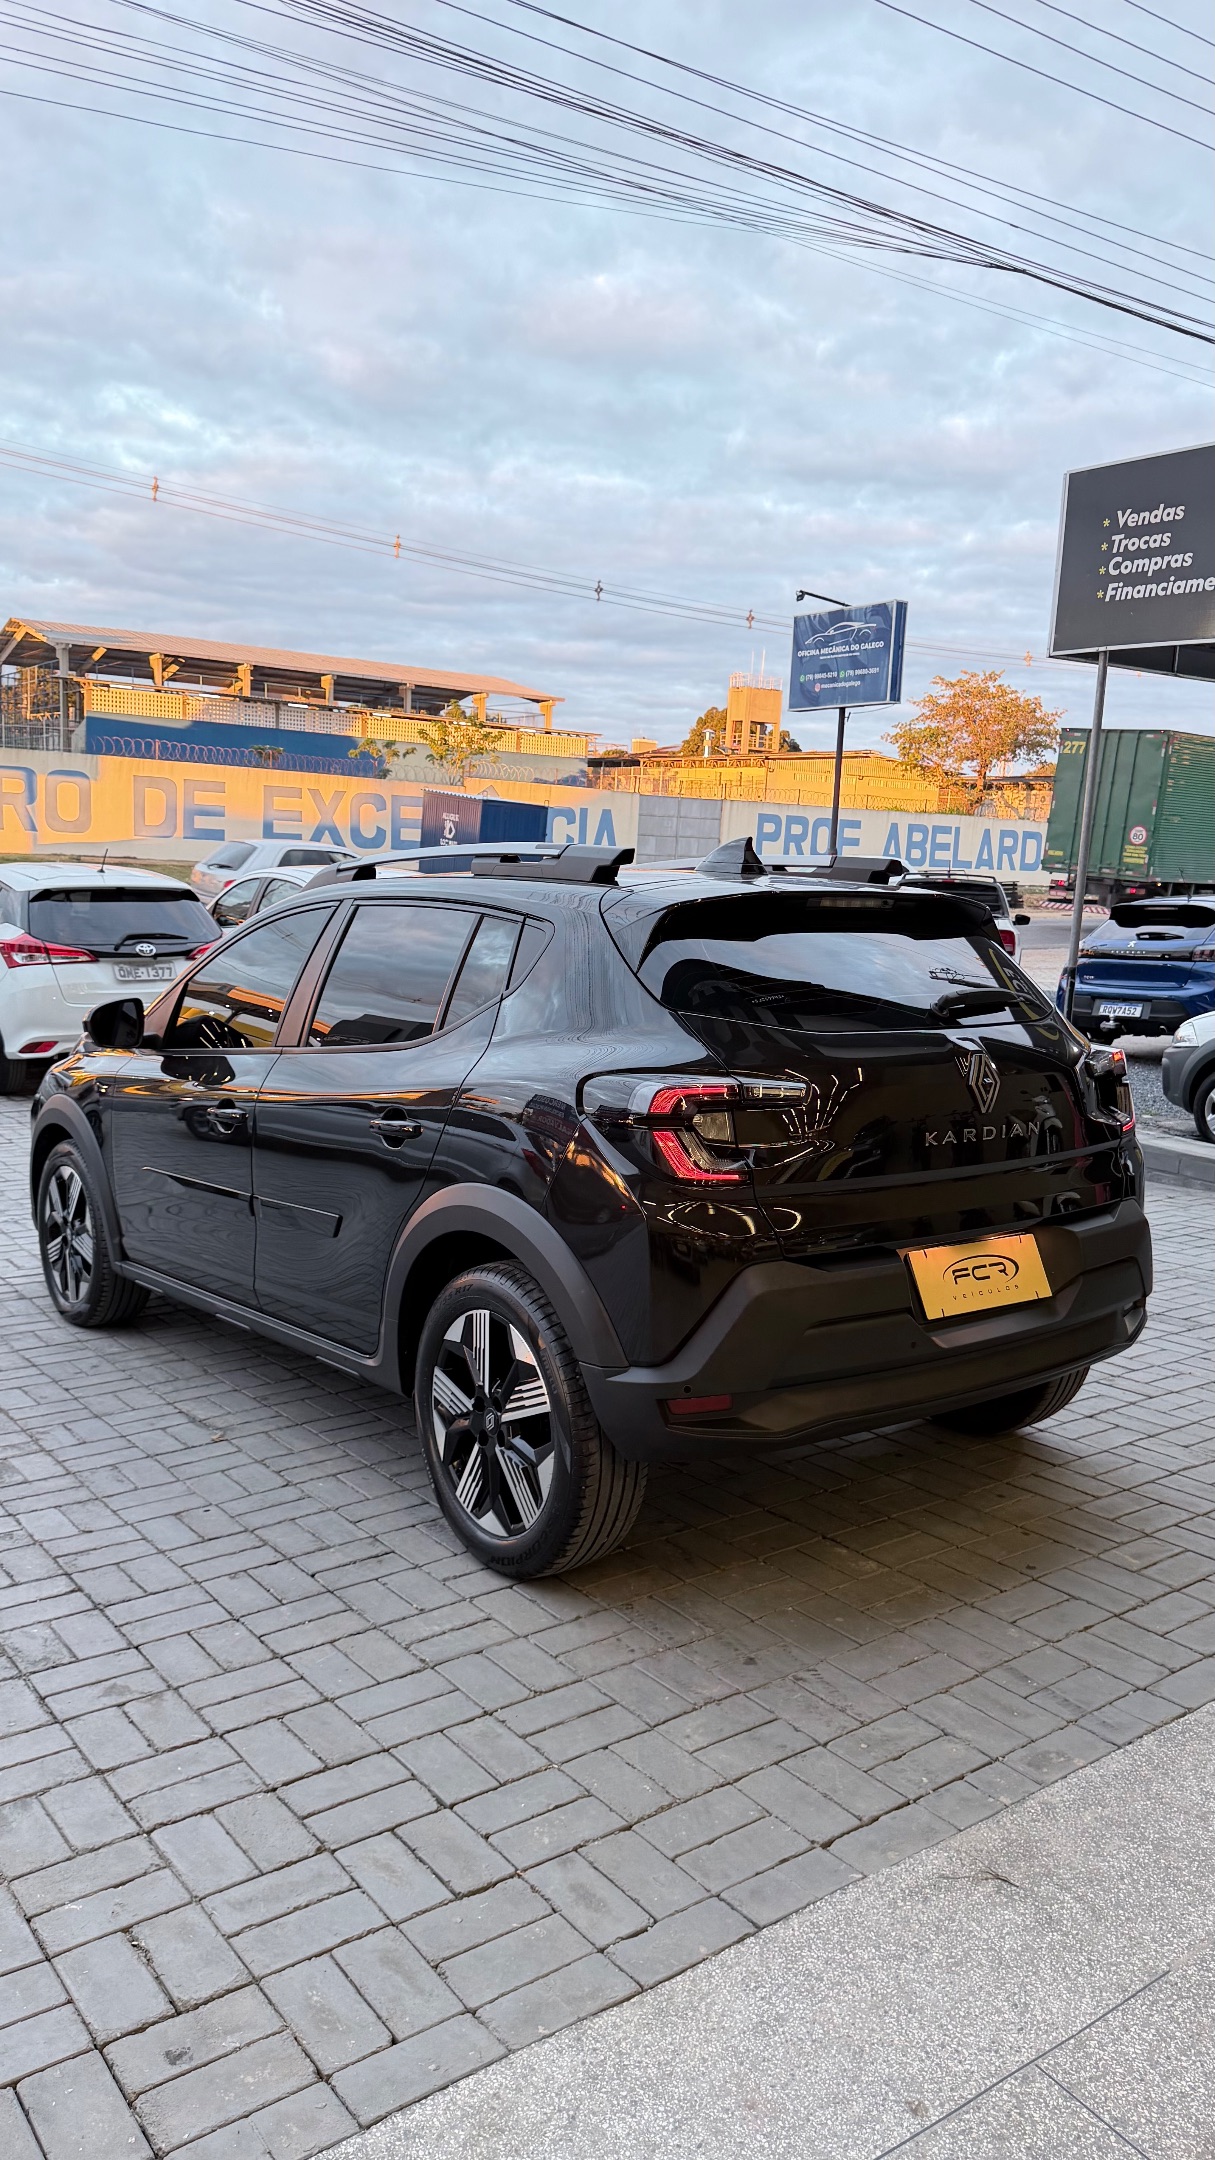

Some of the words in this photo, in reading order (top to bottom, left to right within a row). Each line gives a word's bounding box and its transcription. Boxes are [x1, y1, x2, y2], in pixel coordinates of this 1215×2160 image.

[1117, 504, 1186, 528] Vendas
[1111, 532, 1172, 553] Trocas
[1108, 552, 1194, 577] Compras
[1104, 576, 1215, 602] Financiame
[797, 649, 820, 657] OFICINA
[820, 644, 849, 654] MECÂNICA
[850, 642, 860, 651] DO
[860, 640, 884, 649] GALEGO
[1063, 741, 1086, 754] 277
[132, 774, 227, 842] DE
[754, 812, 862, 856] PROF
[1132, 832, 1144, 841] 80
[925, 1121, 1041, 1147] KARDIAN
[951, 1261, 1009, 1285] FCR
